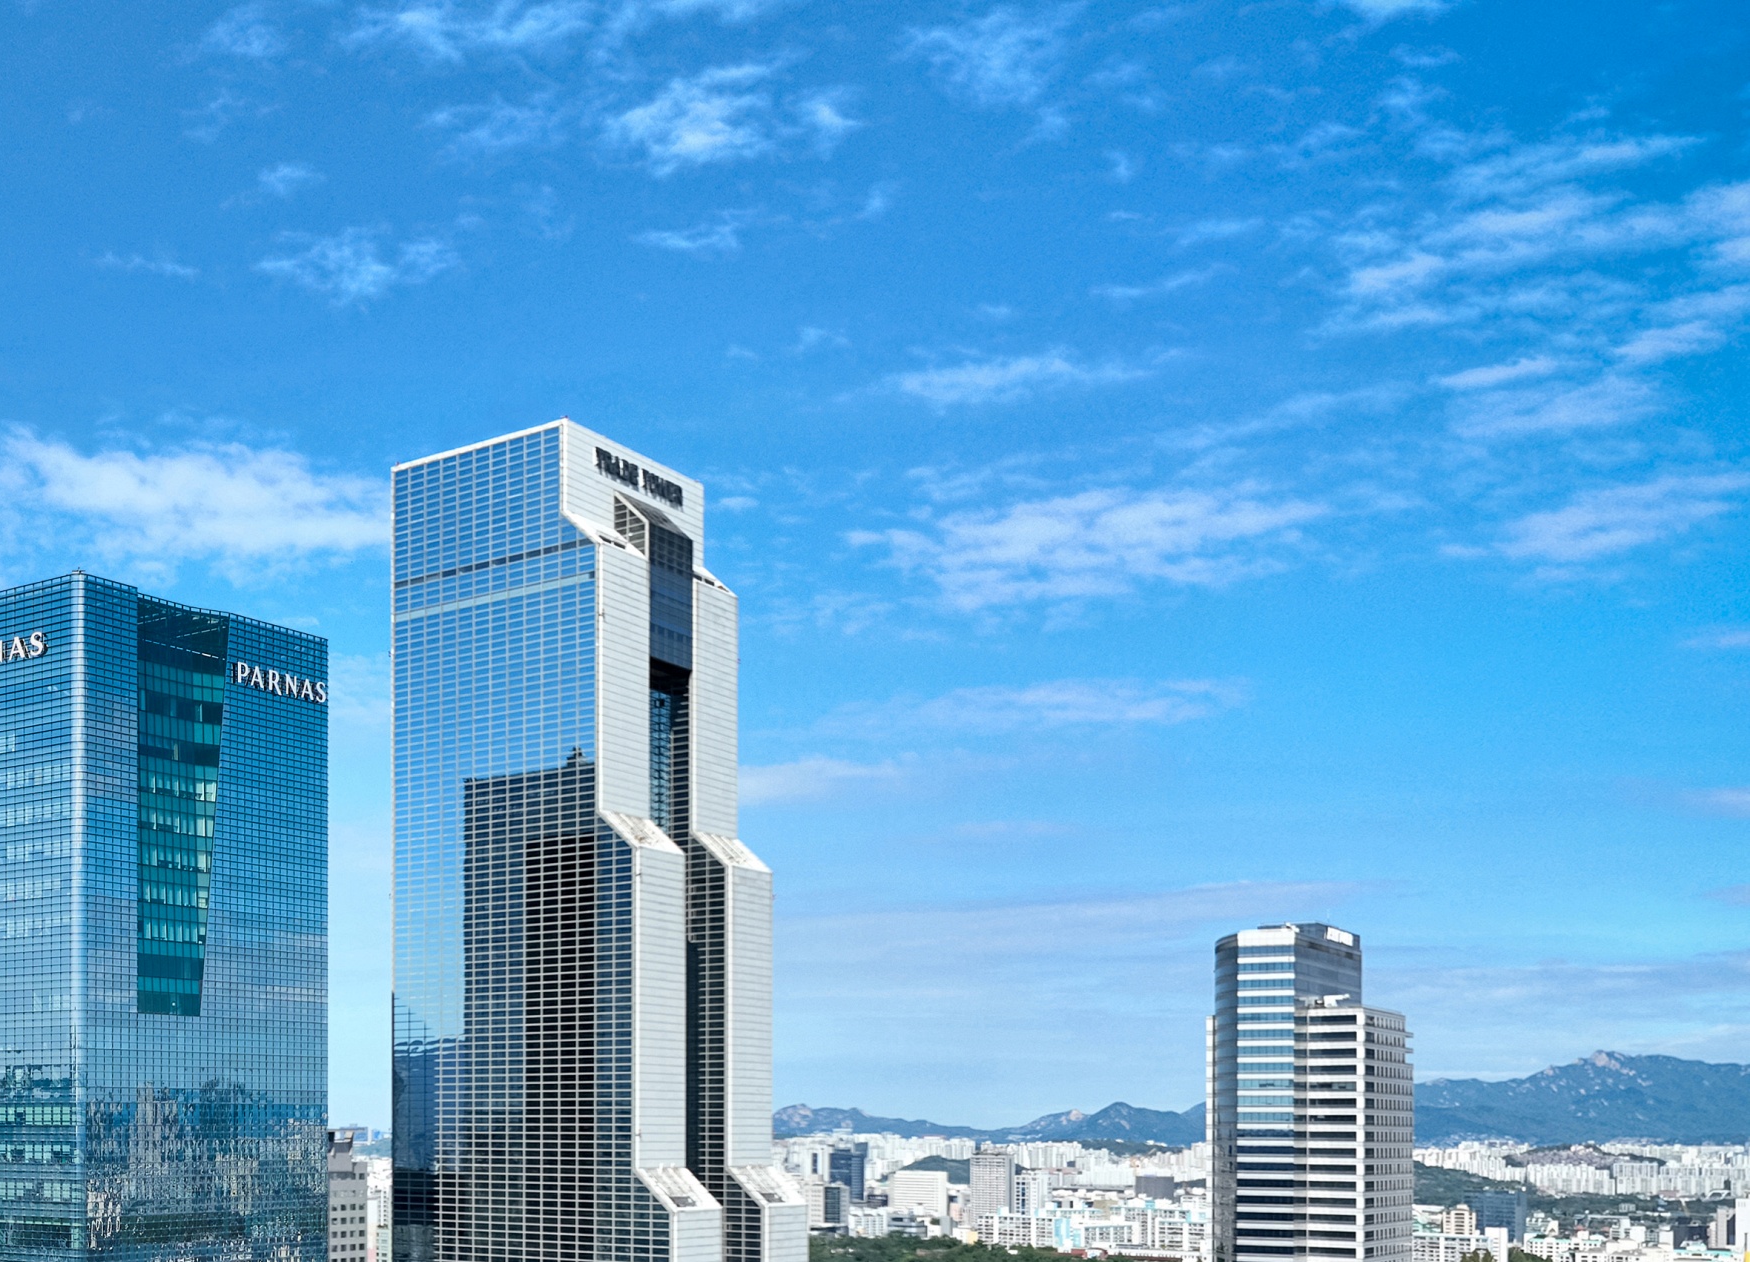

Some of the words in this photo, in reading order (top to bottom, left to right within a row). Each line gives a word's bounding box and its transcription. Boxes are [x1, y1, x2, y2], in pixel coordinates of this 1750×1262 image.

[593, 446, 639, 489] TRADE
[640, 467, 684, 508] TOWER
[236, 661, 327, 703] PARNAS
